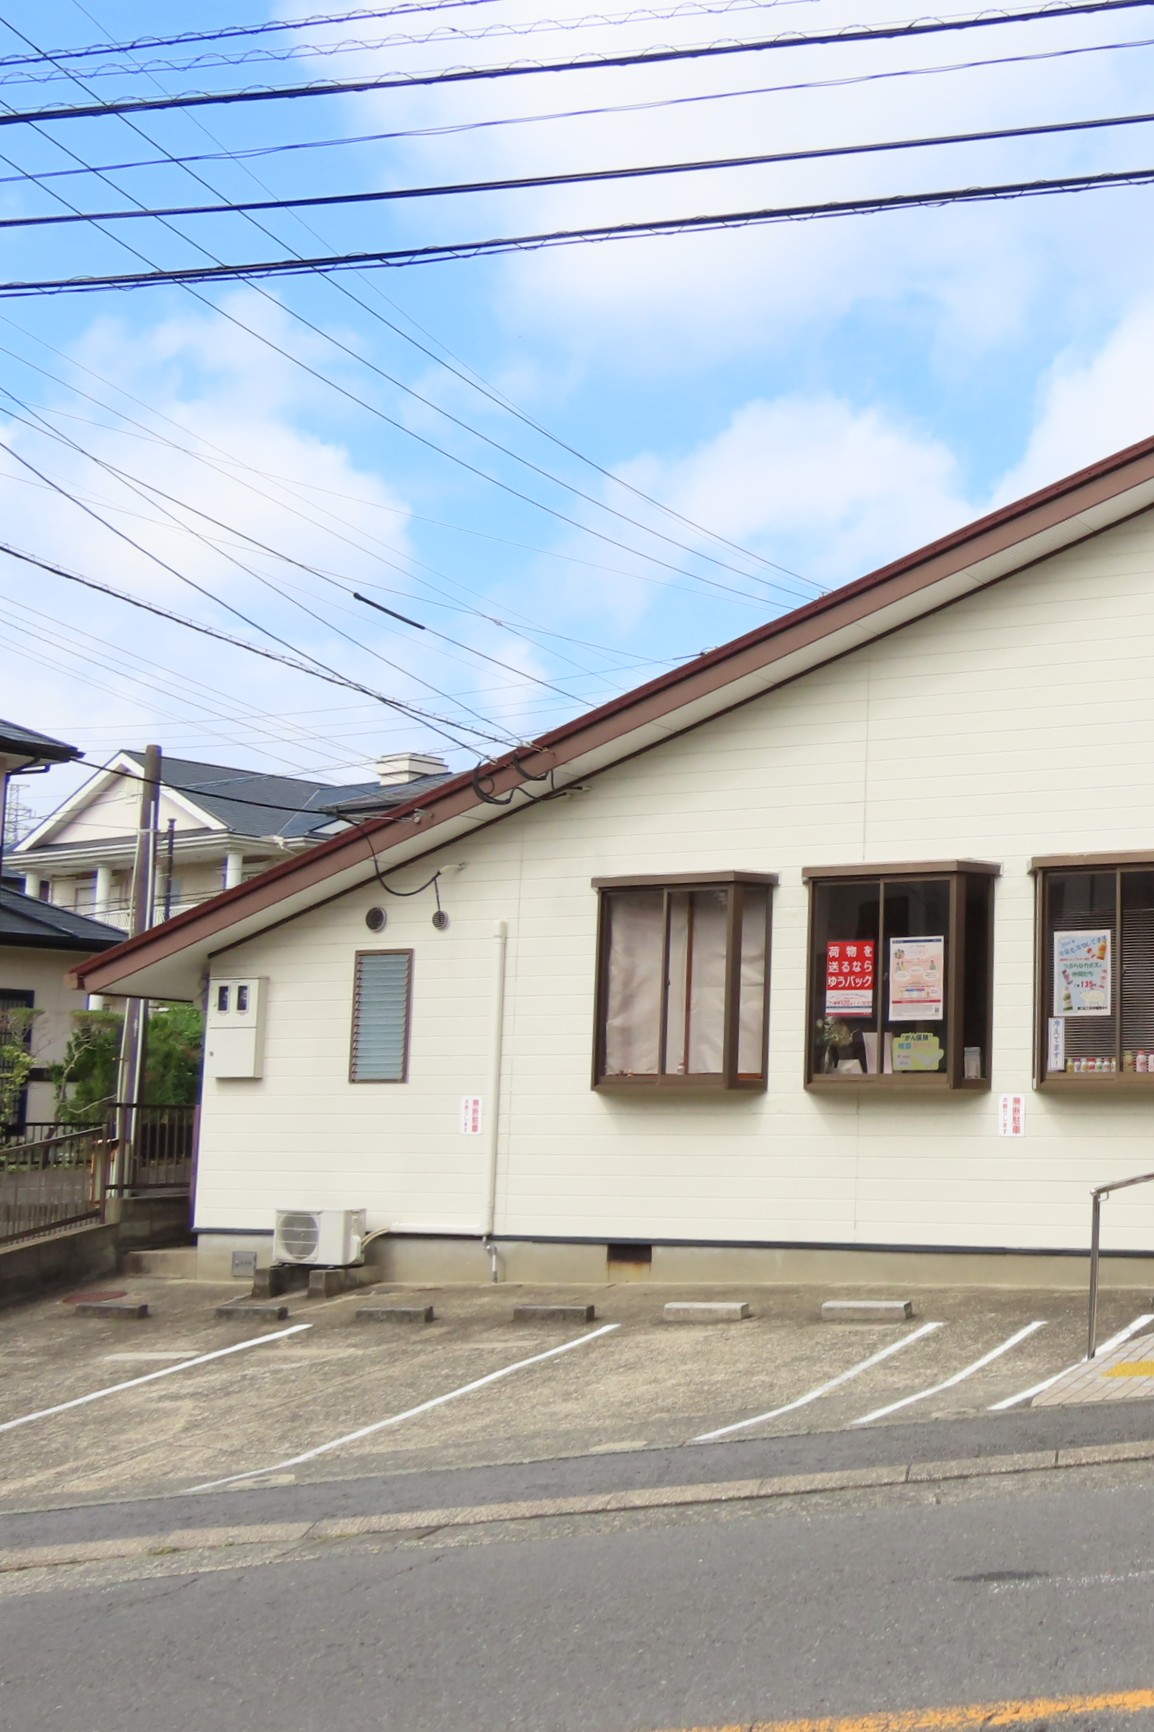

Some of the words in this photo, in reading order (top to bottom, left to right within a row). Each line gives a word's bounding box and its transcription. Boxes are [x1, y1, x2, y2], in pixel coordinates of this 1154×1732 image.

[828, 945, 872, 958] 荷物を
[828, 960, 872, 973] 送るなら
[828, 976, 872, 988] ゆうパック
[1013, 1097, 1021, 1134] 無断駐車
